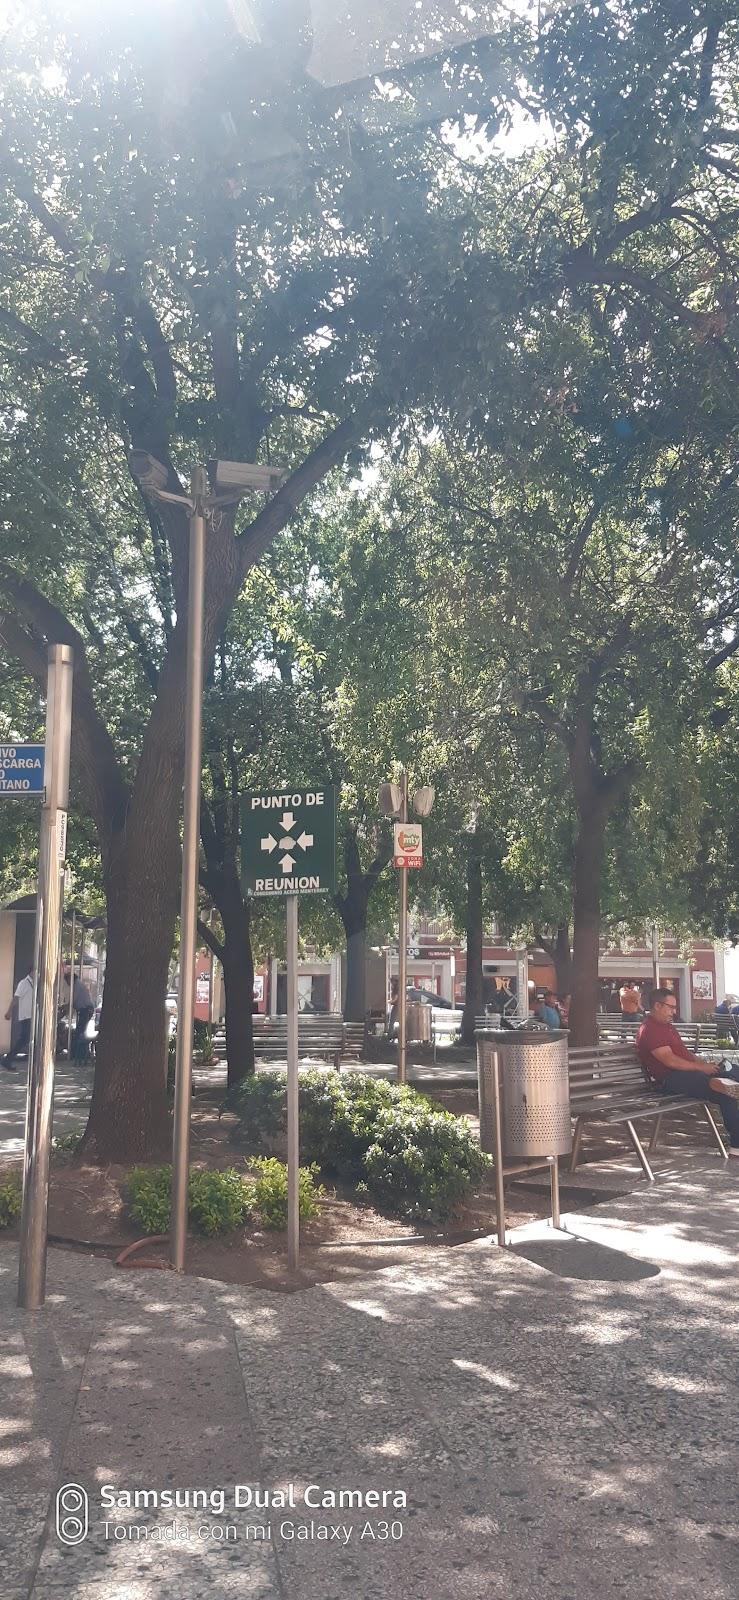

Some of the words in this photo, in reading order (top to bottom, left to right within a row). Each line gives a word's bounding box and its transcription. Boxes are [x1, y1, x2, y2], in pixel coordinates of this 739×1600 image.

[251, 794, 302, 810] PUNTO
[306, 792, 324, 806] DE
[255, 876, 320, 891] REUNION
